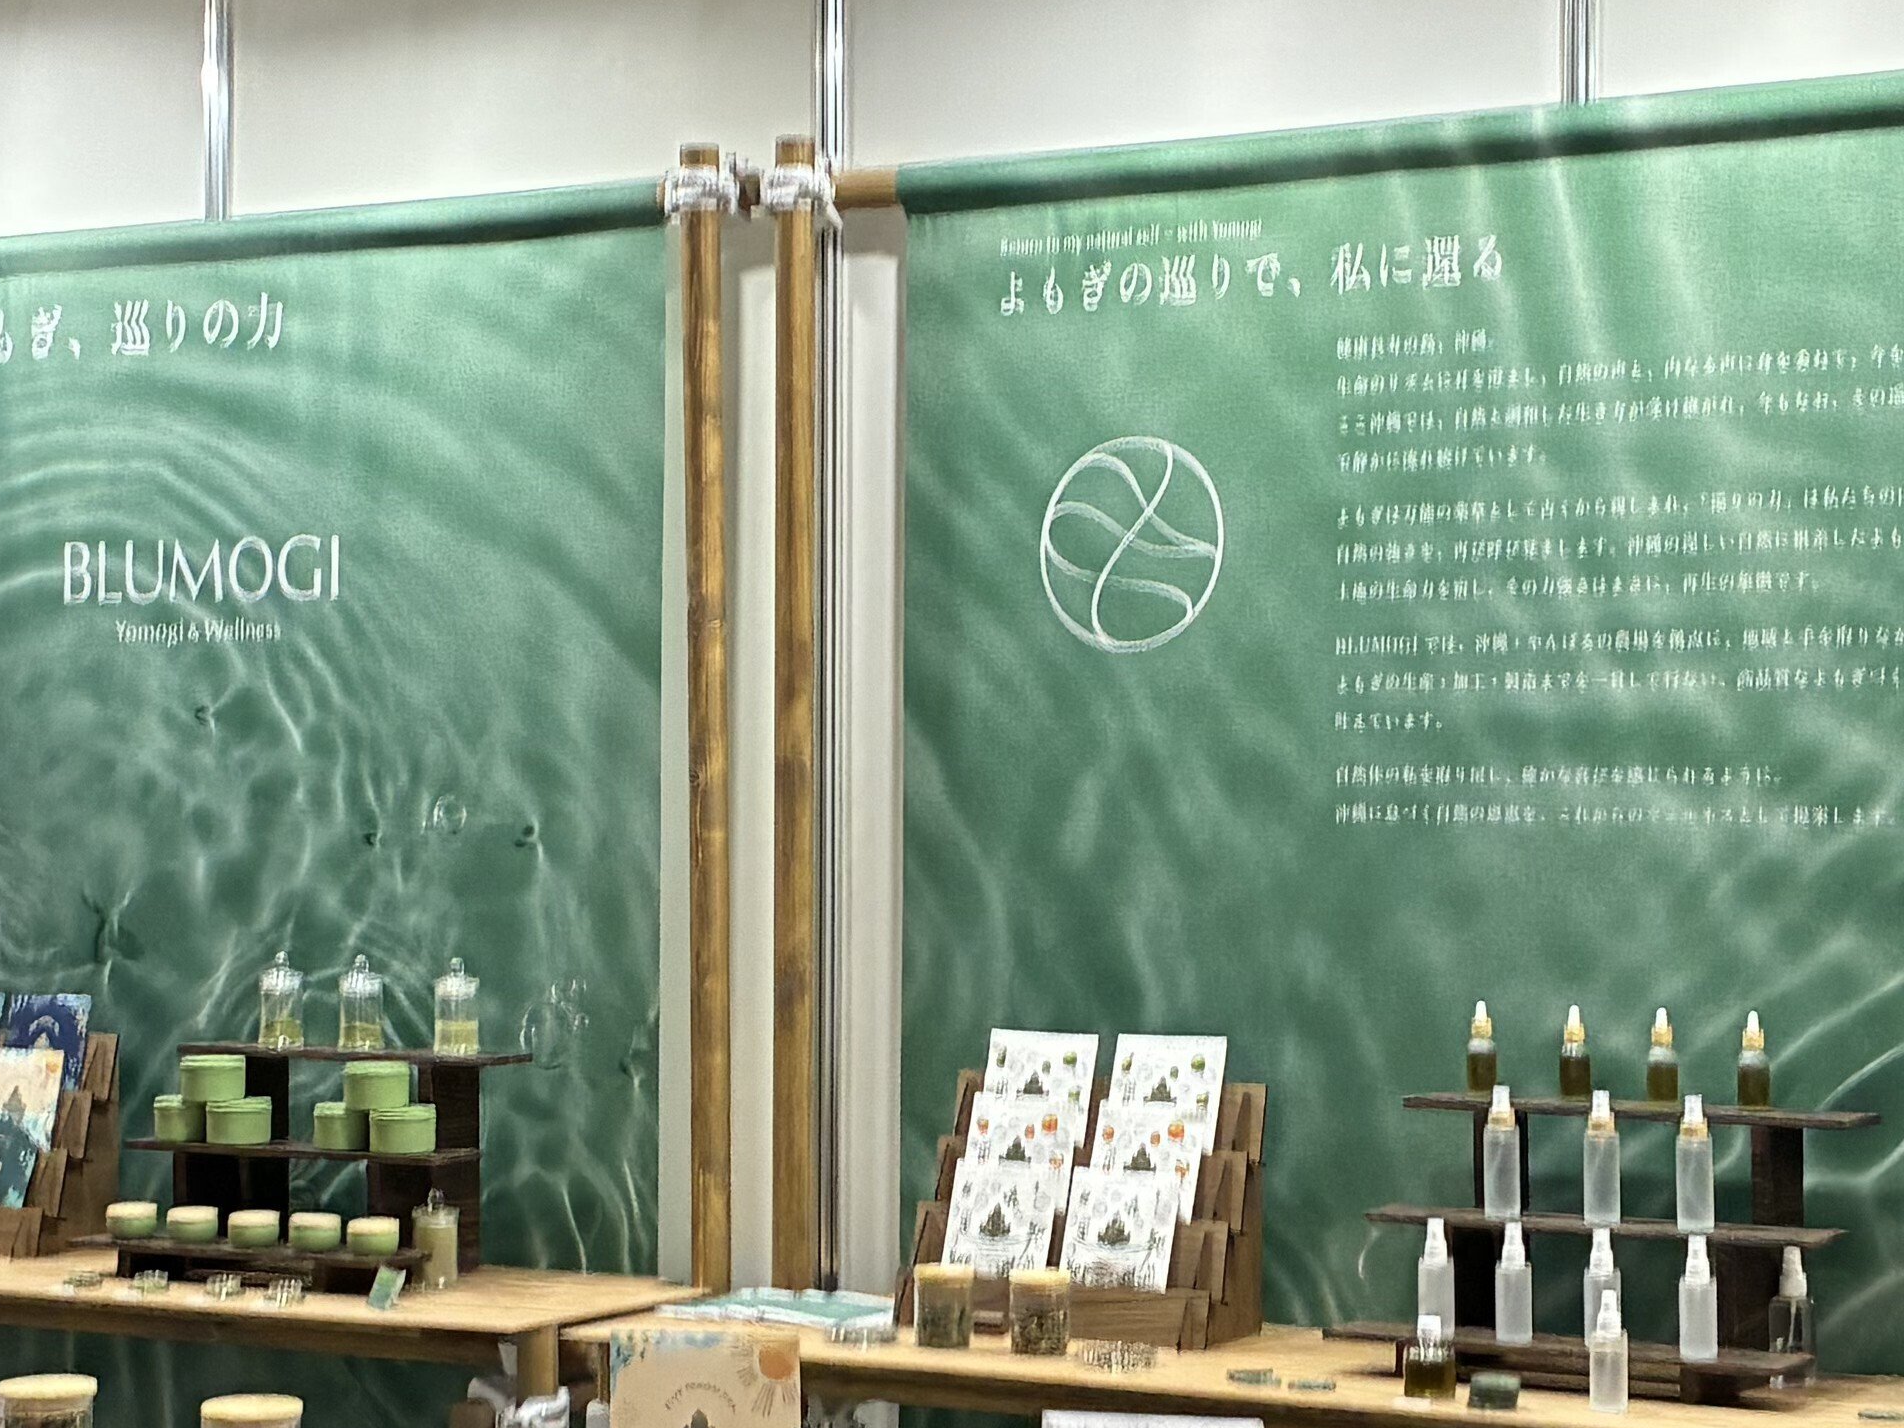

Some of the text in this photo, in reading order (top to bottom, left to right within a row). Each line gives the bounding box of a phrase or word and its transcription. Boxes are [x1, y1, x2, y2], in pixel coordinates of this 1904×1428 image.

[1000, 234, 1504, 316] よもぎの巡りで、私に還る
[63, 533, 340, 606] BLUMOGI
